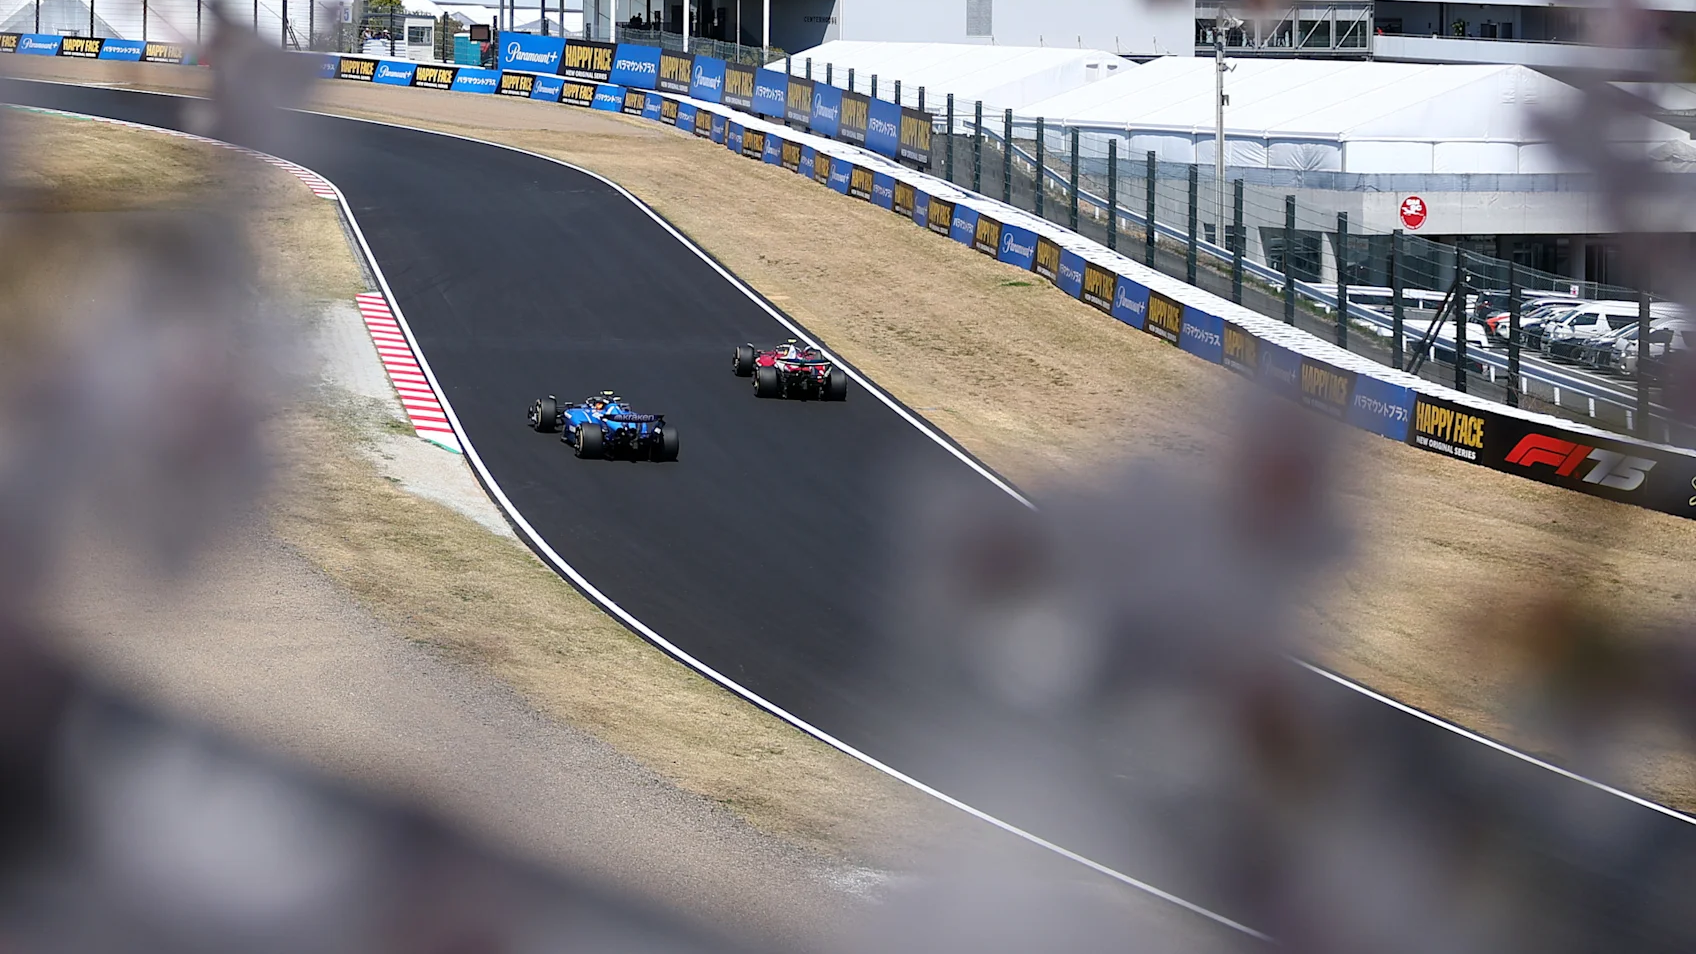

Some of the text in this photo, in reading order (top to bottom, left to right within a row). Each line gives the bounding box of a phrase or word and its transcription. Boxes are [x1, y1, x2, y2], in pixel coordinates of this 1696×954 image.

[344, 8, 349, 21] 5
[1, 35, 17, 48] FACE
[21, 37, 58, 50] Paramount+
[63, 38, 100, 53] HAPPY FACE
[146, 44, 182, 58] HAPPY FACE
[505, 42, 558, 64] Paramount+
[565, 44, 612, 71] HAPPY FACE
[341, 59, 360, 74] HAPPY
[360, 61, 374, 76] FACE
[378, 65, 413, 79] Paramount+
[416, 67, 453, 84] HAPPY FACE
[575, 70, 593, 79] ORIGINAL
[616, 59, 656, 73] パラマウントプラス
[660, 55, 691, 83] HAPPY FACE
[457, 77, 496, 86] パラマウントプラス
[501, 75, 533, 91] HAPPY FACE
[694, 65, 721, 90] Paramount+
[725, 68, 753, 97] HAPPY FACE
[563, 83, 594, 101] HAPPY FACE
[901, 114, 931, 151] HAPPY FACE
[1002, 232, 1034, 259] Paramount+
[1085, 267, 1102, 297] HAPPY
[1102, 274, 1113, 301] FACE
[1116, 286, 1145, 314] Paramount+
[1148, 295, 1180, 334] HAPPY FACE
[1302, 363, 1330, 399] HAPPY
[1354, 395, 1408, 422] パラマウントプラス
[1416, 400, 1485, 449] HAPPY FACE
[1416, 435, 1476, 460] NEW ORIGINAL SERIES
